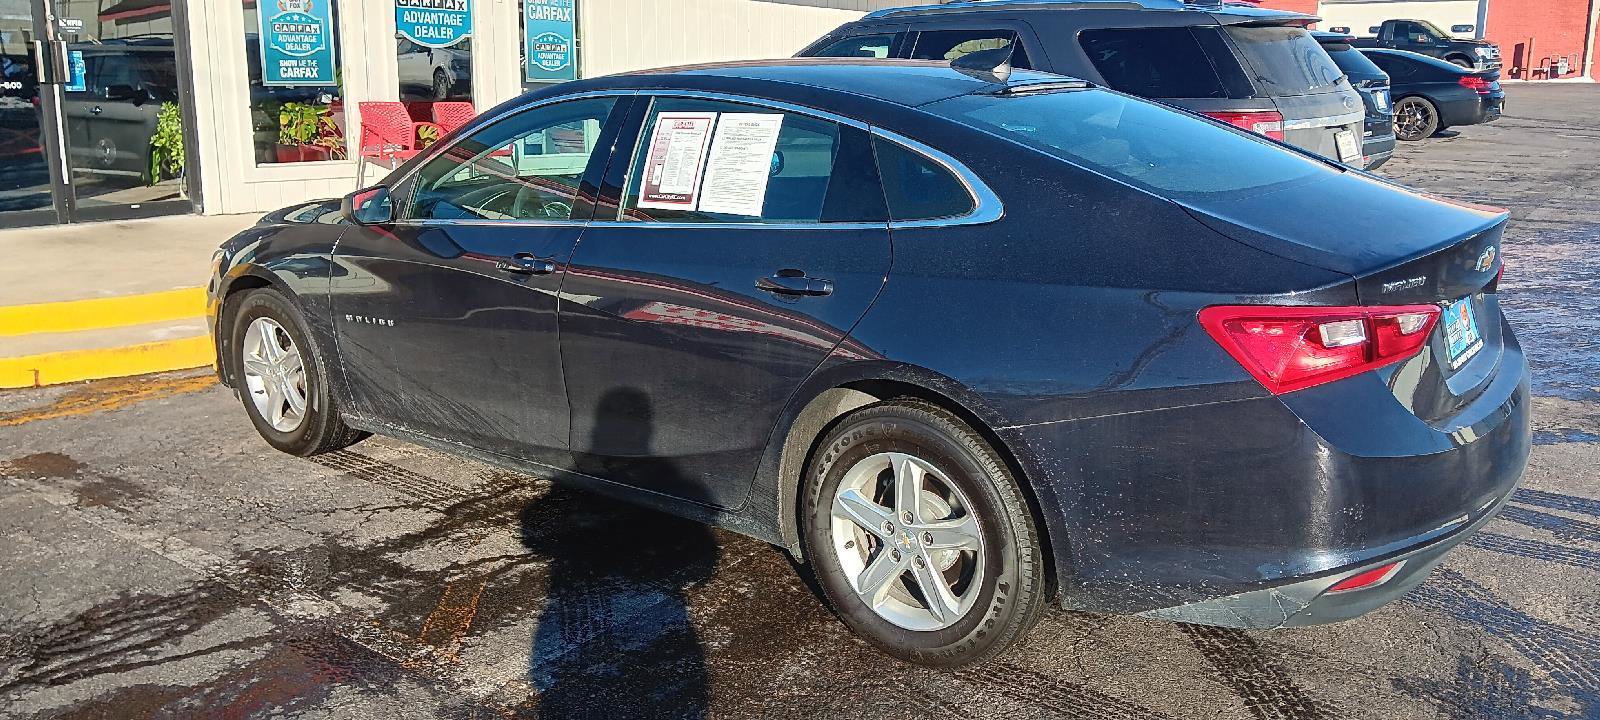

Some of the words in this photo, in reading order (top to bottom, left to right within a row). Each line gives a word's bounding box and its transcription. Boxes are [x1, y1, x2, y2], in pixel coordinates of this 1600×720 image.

[403, 11, 463, 26] ADVANTAGE
[529, 5, 572, 22] CARFAX
[274, 23, 318, 33] CARFAX
[414, 26, 454, 39] DEALER
[278, 34, 318, 43] ADVANTAGE
[285, 43, 312, 51] DEALER
[280, 67, 319, 78] CARFAX
